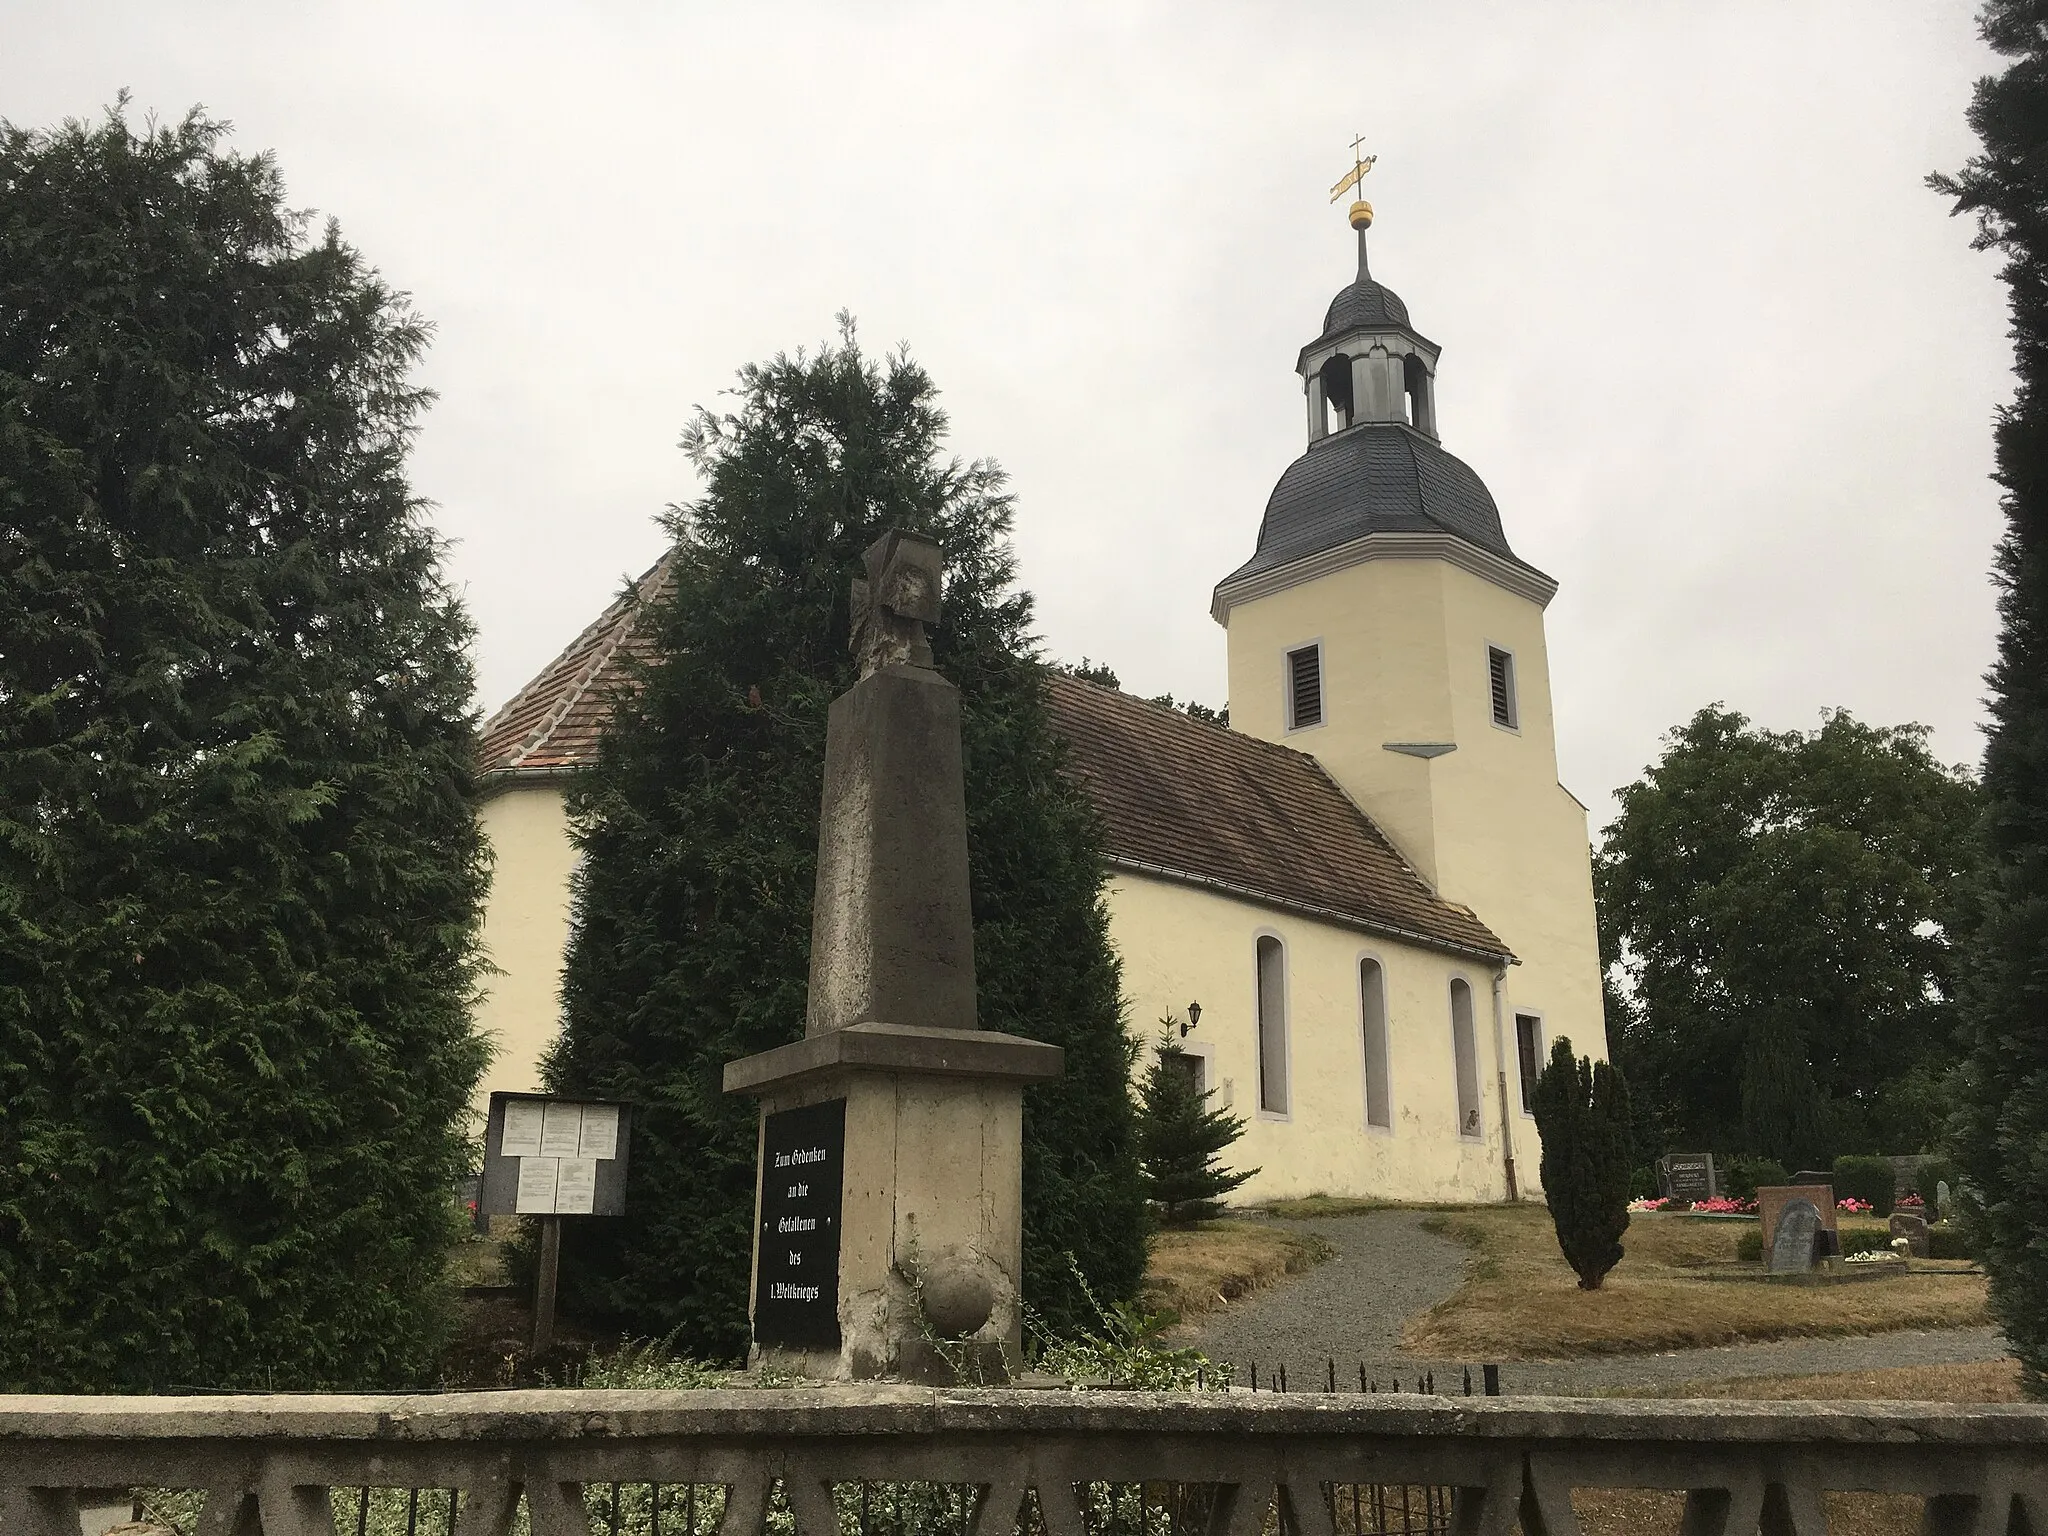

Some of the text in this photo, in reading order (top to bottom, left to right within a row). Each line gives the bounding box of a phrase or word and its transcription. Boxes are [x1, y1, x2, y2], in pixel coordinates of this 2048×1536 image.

[774, 1146, 826, 1168] Zum Gedenken
[787, 1180, 809, 1198] an die
[778, 1215, 816, 1233] Gefallenen
[789, 1249, 802, 1266] des
